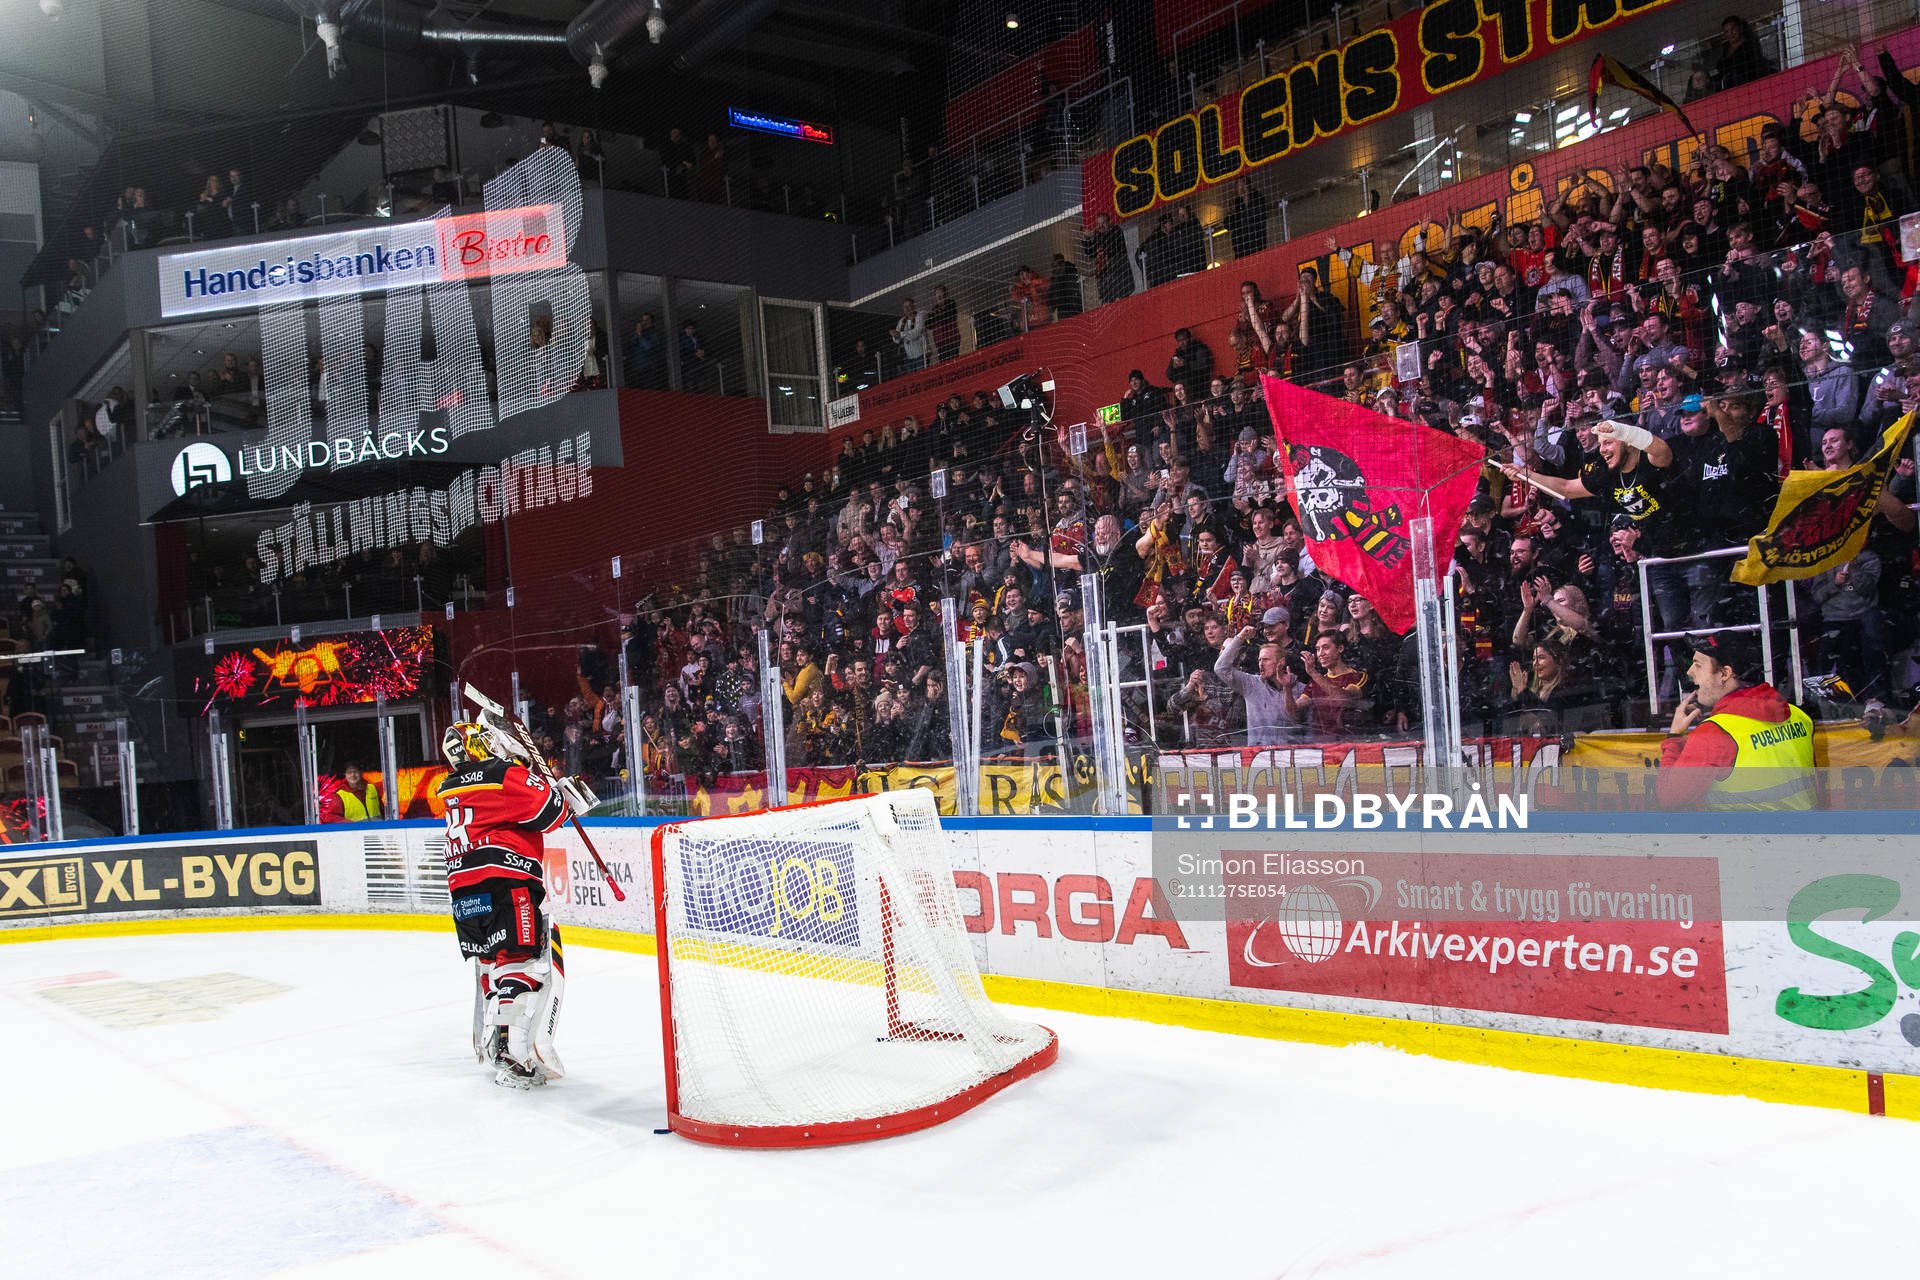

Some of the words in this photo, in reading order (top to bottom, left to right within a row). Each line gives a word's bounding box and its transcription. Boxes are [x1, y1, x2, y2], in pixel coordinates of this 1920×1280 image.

[1112, 27, 1402, 220] SOLENS
[183, 242, 437, 300] Handelsbanken
[452, 228, 553, 266] Bistro
[237, 426, 451, 477] LUNDBÄCKS
[513, 721, 555, 782] BAUER
[92, 850, 316, 905] XL-BYGG
[572, 859, 634, 884] SVENSKA
[574, 885, 607, 908] SPEL
[1396, 878, 1466, 910] Smart
[1472, 882, 1489, 907] &
[1493, 883, 1561, 925] trygg
[1567, 879, 1696, 931] förvaring
[1344, 920, 1700, 983] Arkivexperten.se
[547, 996, 560, 1037] BAUER
